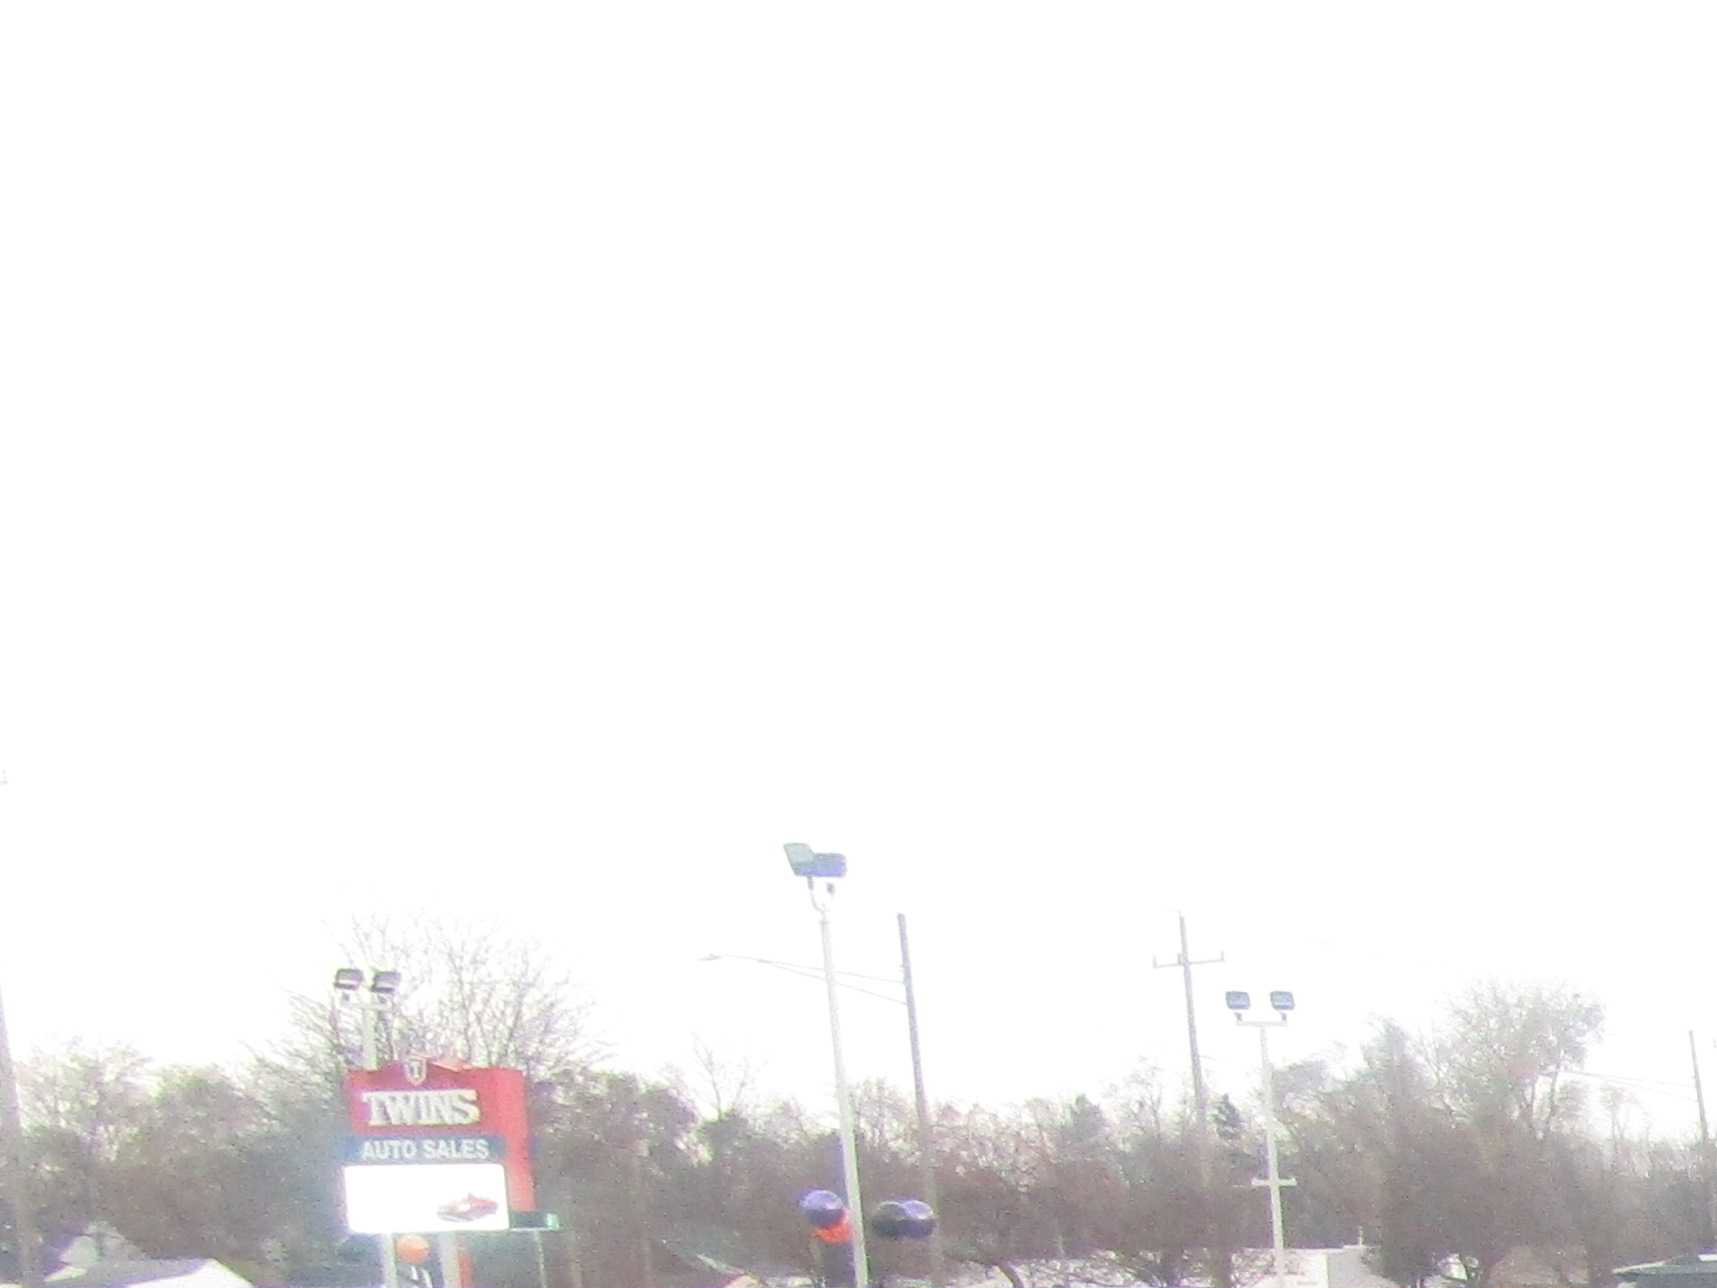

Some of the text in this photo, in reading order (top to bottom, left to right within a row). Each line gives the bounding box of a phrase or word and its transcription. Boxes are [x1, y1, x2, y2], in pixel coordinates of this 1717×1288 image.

[362, 1089, 480, 1127] TWINS
[361, 1140, 489, 1160] AUTO SALES
